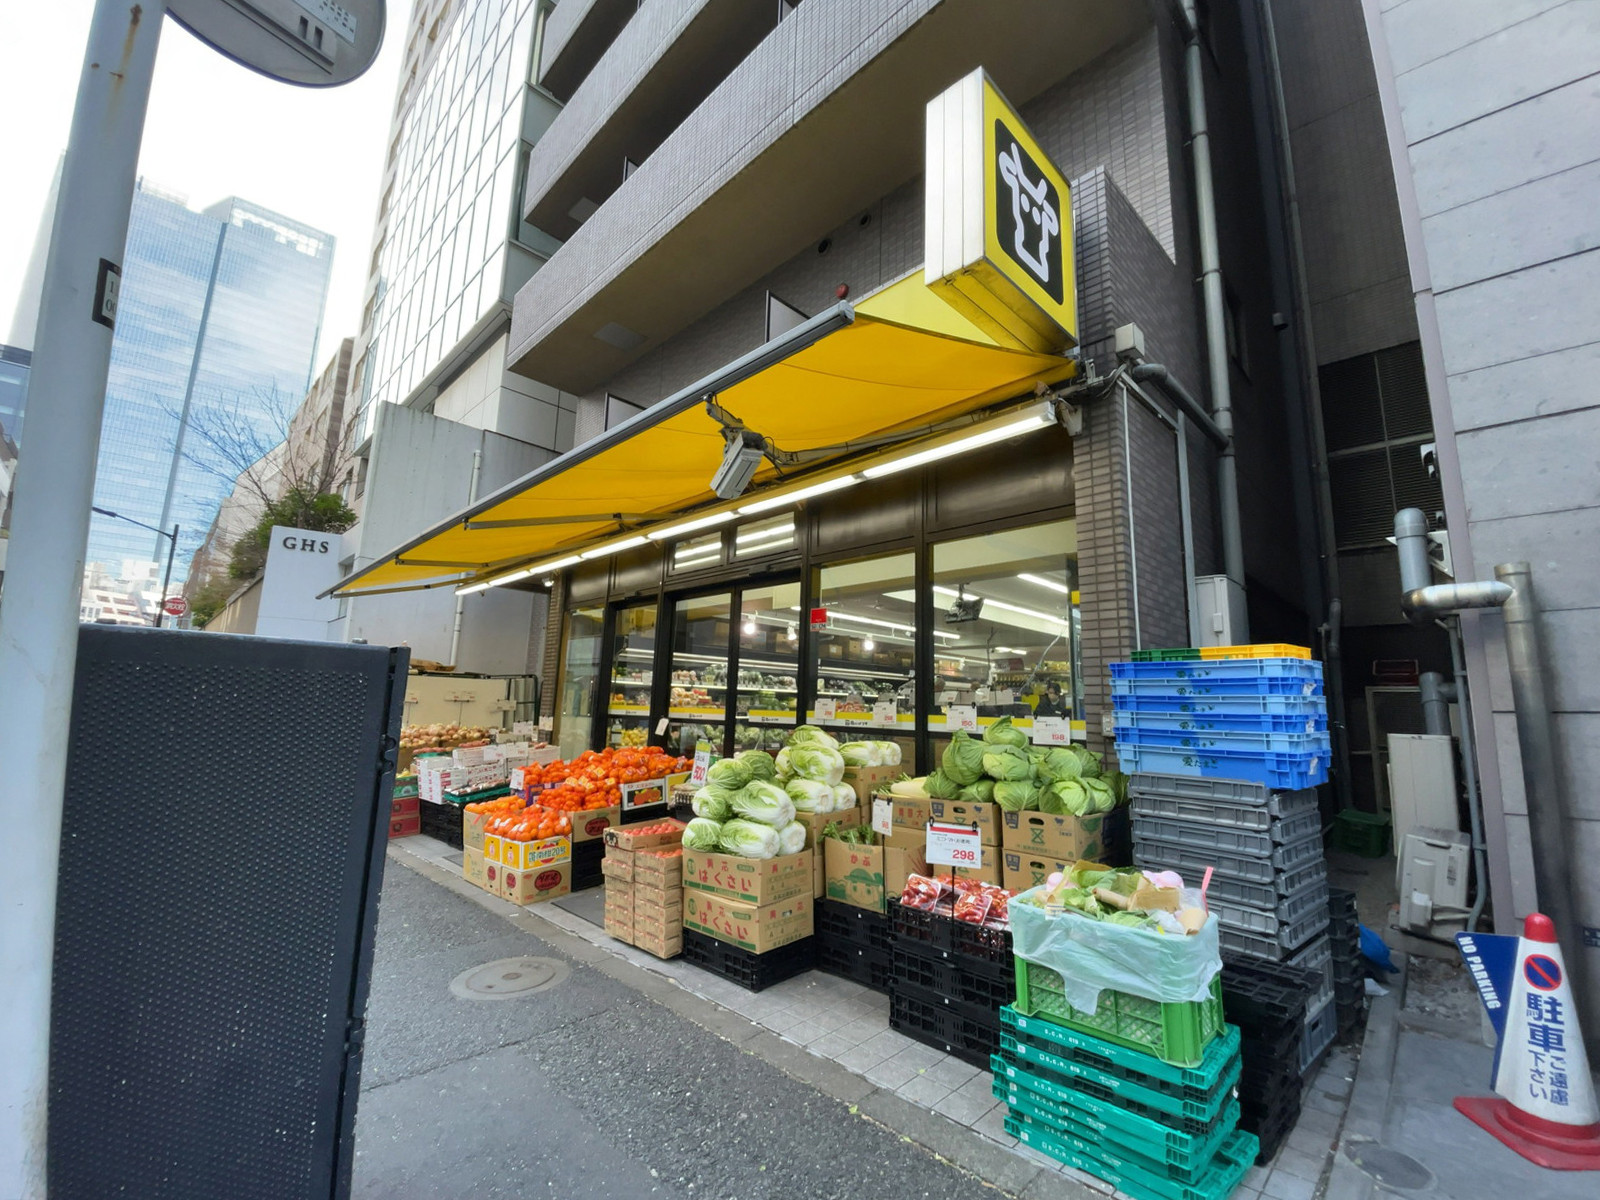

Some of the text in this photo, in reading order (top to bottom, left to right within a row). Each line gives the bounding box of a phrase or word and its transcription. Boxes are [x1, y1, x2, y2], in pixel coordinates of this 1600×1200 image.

[282, 536, 330, 554] GHS
[952, 849, 975, 861] 298
[698, 868, 752, 892] はくさい
[699, 910, 748, 940] はくさい
[1458, 936, 1502, 1010] NO PARKING
[1526, 992, 1566, 1053] 駐車
[1528, 1049, 1549, 1100] 下さい
[1550, 1055, 1570, 1107] ご遠慮
